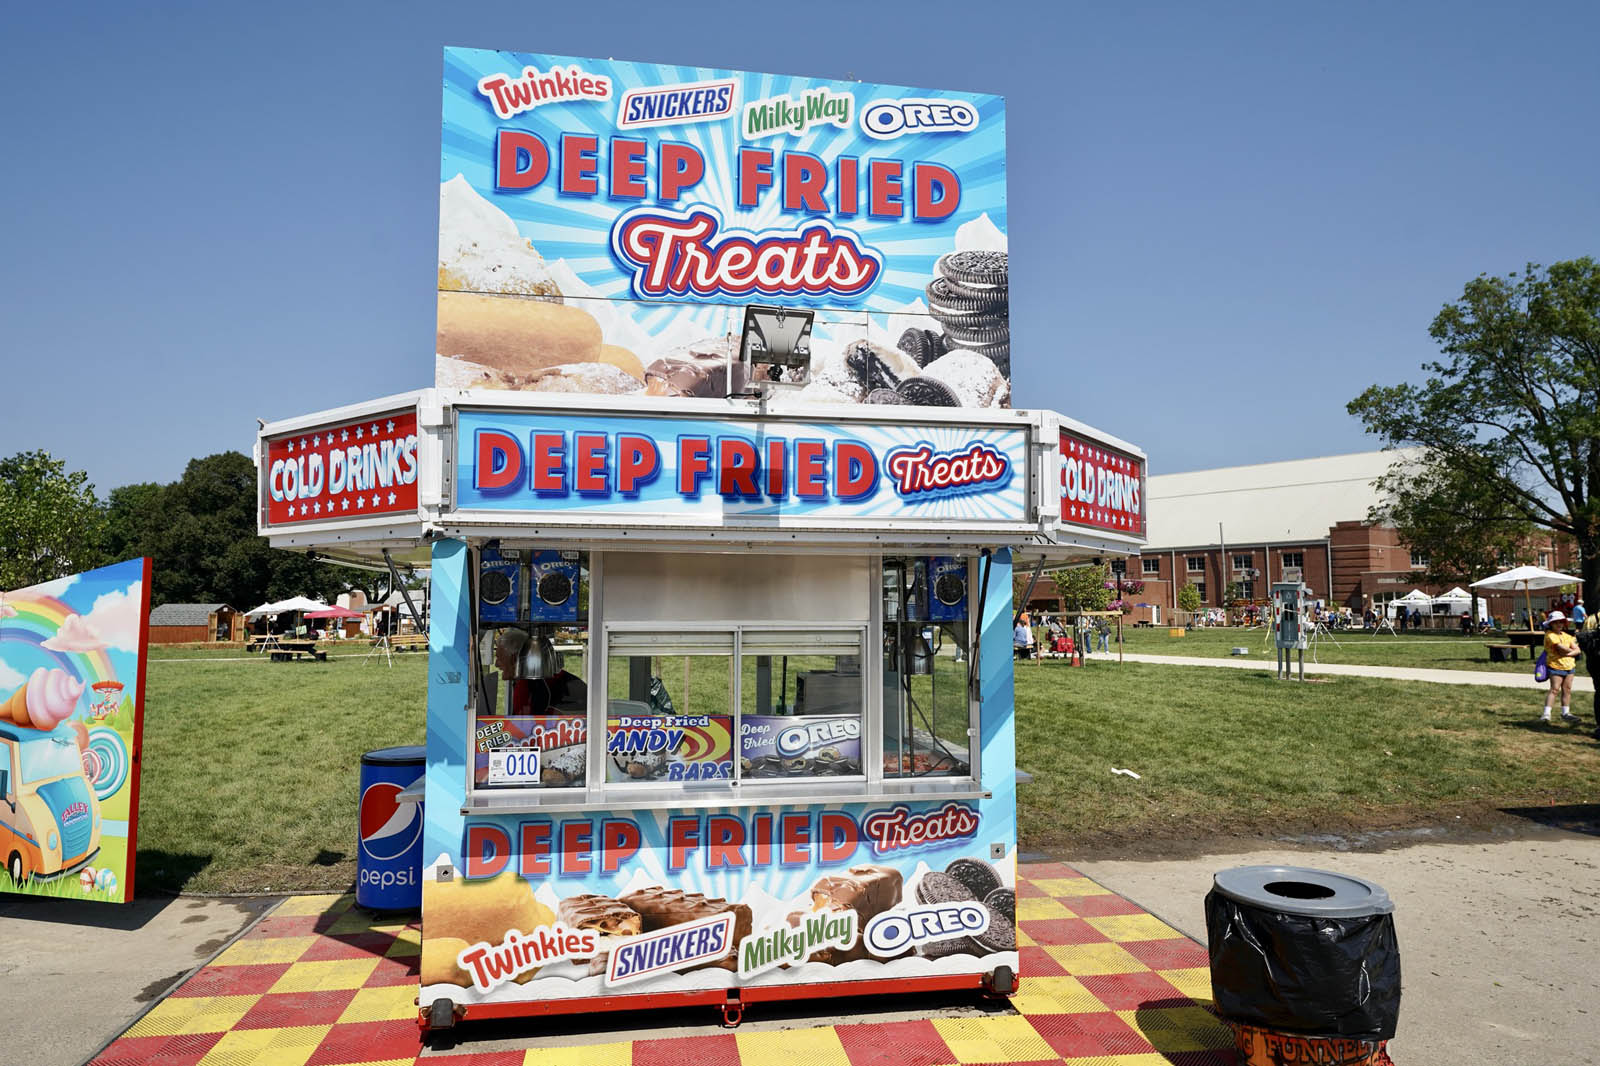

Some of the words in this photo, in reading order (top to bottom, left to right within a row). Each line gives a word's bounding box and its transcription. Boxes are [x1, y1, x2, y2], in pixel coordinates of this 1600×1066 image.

[484, 71, 608, 114] Twinkies
[628, 87, 731, 122] SNICKERS
[865, 104, 974, 134] OREO
[495, 127, 704, 201] DEEP
[737, 147, 961, 222] FRIED
[628, 218, 872, 290] Treats
[270, 453, 324, 502] COLD
[329, 434, 418, 494] DRINKS
[473, 427, 661, 496] DEEP
[677, 435, 878, 500] FRIED
[892, 446, 1006, 494] Treats
[1098, 466, 1139, 515] DRINKS
[476, 721, 504, 740] DEEP
[620, 717, 661, 729] Deep
[665, 715, 709, 727] Fried
[740, 723, 771, 736] Deep
[778, 719, 861, 755] OREO
[479, 732, 513, 752] FRIED
[606, 729, 684, 752] ANDY
[744, 735, 777, 749] Fried
[506, 753, 538, 776] 010
[668, 761, 733, 781] BARS
[465, 818, 641, 880] DEEP
[669, 811, 860, 872] FRIED
[870, 807, 977, 850] Treats
[360, 866, 416, 890] pepsi
[869, 907, 984, 951] OREO
[463, 928, 595, 988] Twinkies
[617, 922, 725, 977] SNICKERS
[1263, 1033, 1369, 1063] FUNNEL
